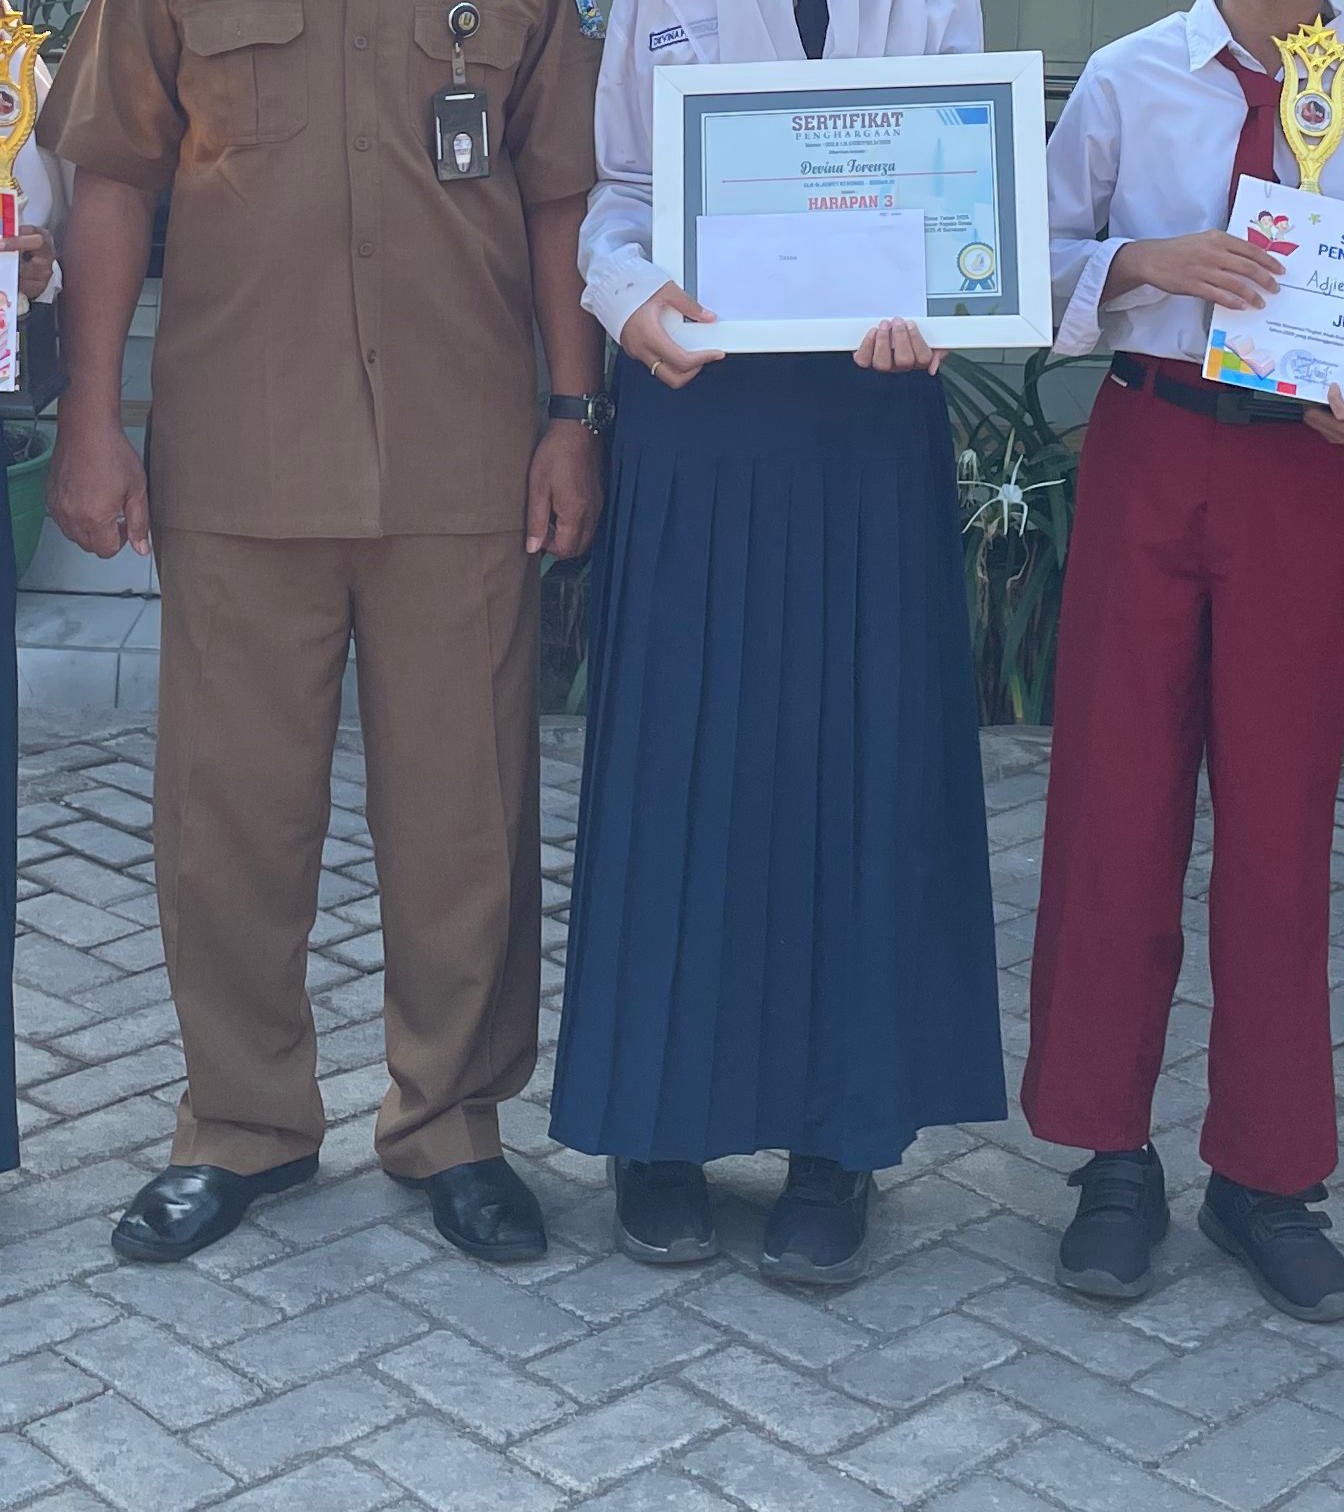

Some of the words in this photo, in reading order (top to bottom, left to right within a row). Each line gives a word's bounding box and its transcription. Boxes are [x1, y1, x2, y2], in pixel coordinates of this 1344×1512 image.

[791, 111, 904, 132] SERTIFIKAT
[795, 129, 901, 141] PENGHARGAAN
[807, 195, 879, 210] HARAPAN
[884, 194, 894, 208] 3
